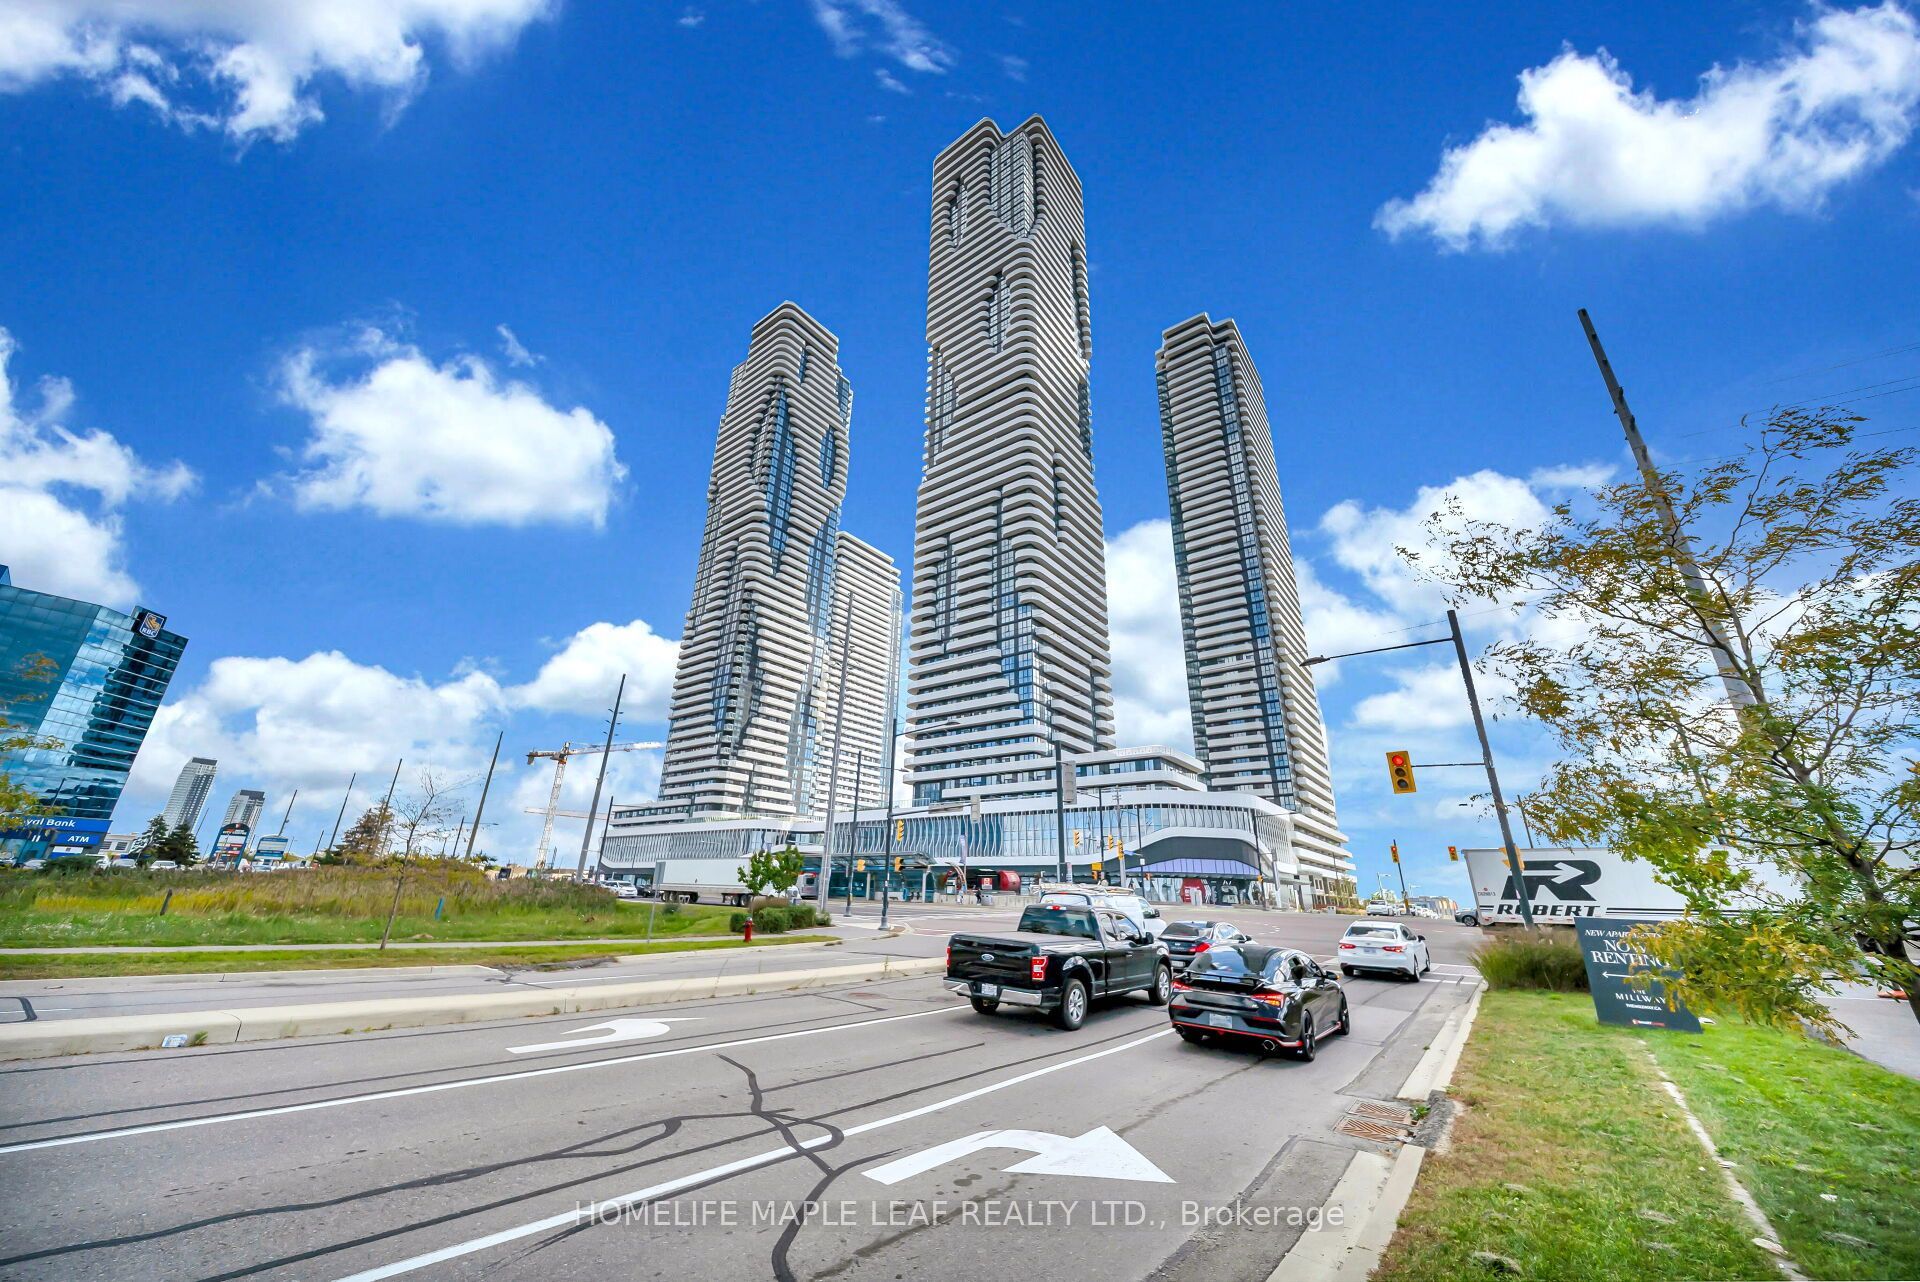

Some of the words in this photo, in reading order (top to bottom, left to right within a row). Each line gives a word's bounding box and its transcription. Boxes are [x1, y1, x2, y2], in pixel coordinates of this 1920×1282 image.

[142, 627, 157, 636] RBC
[46, 819, 76, 828] Bank
[67, 835, 90, 843] ATM
[1584, 929, 1605, 938] NEW
[1603, 939, 1648, 953] NOW
